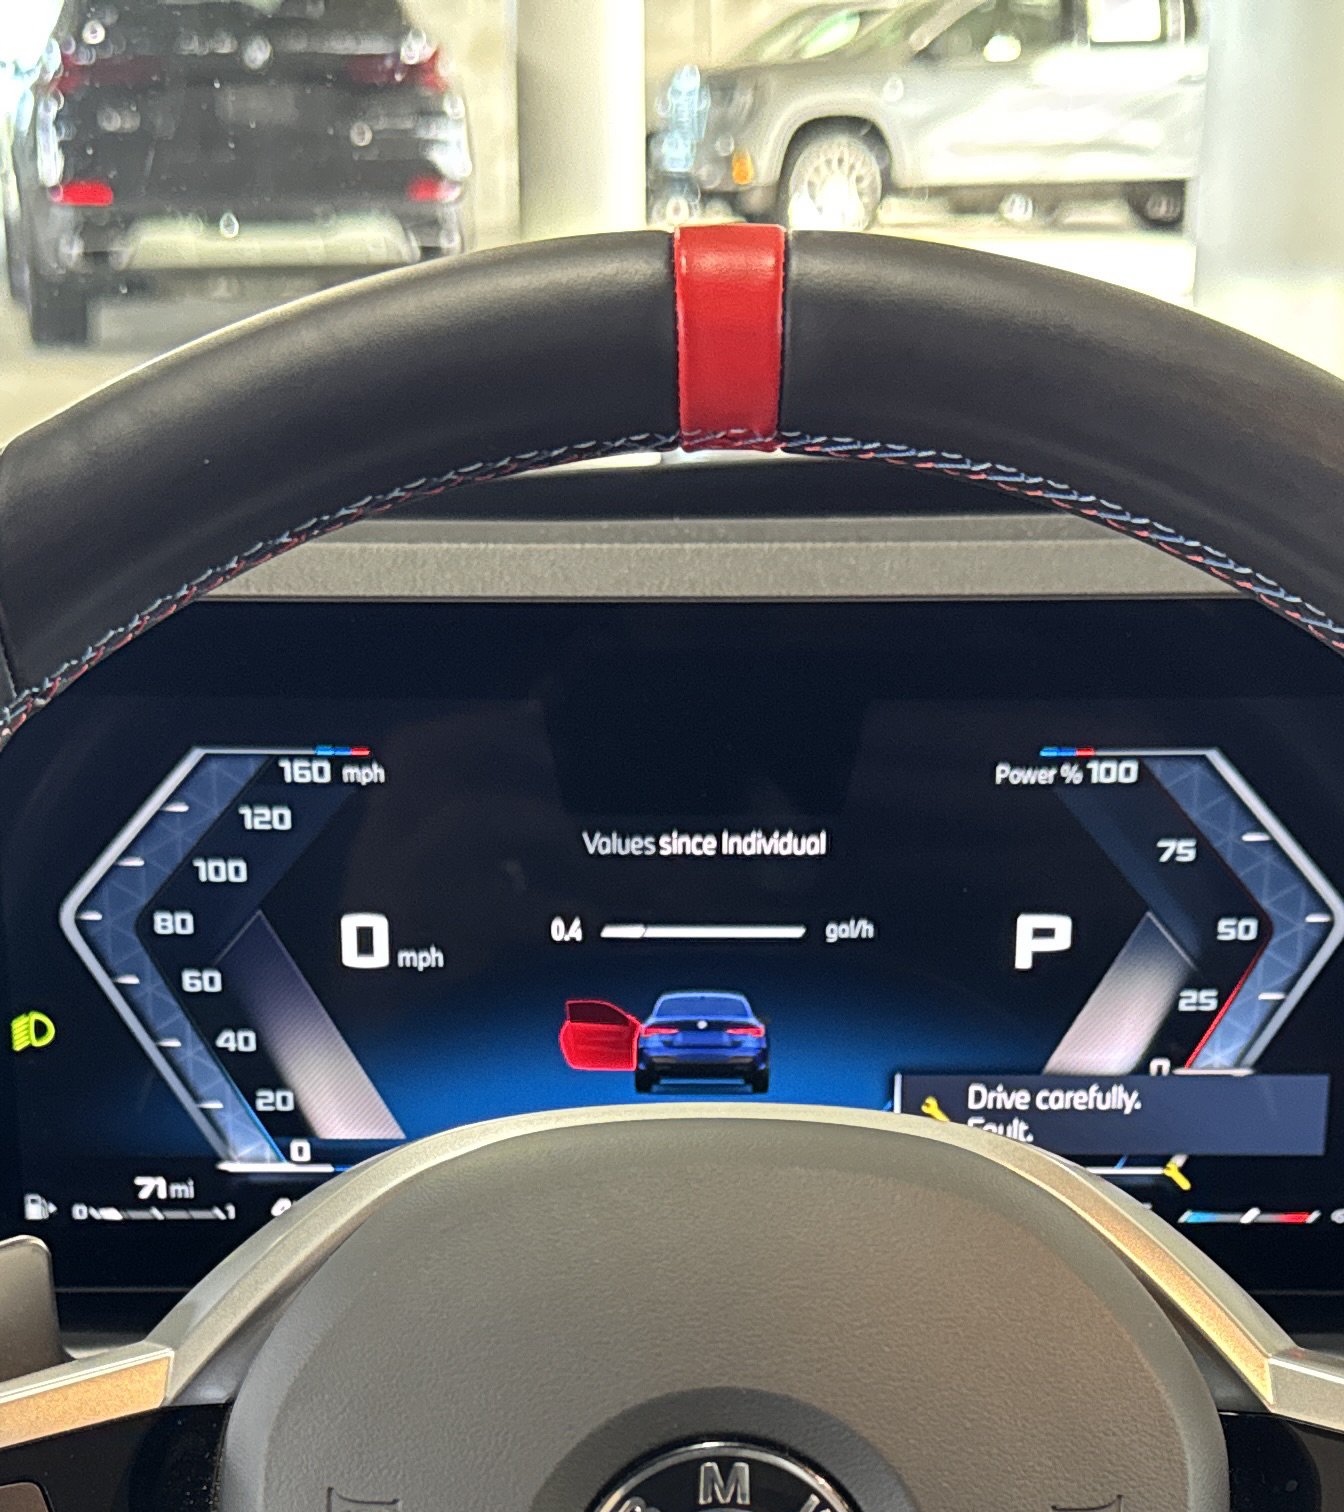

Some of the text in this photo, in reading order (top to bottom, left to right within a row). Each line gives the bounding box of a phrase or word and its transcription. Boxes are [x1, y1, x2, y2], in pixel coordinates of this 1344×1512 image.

[278, 760, 386, 786] 160 mph
[995, 760, 1139, 785] Power % 100
[238, 806, 292, 831] 120
[582, 829, 827, 856] Values since Individual
[1156, 838, 1197, 863] 75
[193, 858, 248, 883] 100
[153, 911, 195, 935] 80
[550, 916, 875, 943] 0.4 gal/h
[1216, 917, 1259, 941] 50
[341, 913, 445, 972] 0 mph
[1014, 913, 1073, 970] P
[181, 969, 222, 993] 60
[1178, 989, 1218, 1012] 25
[215, 1029, 257, 1052] 40
[255, 1090, 295, 1112] 20
[967, 1083, 1142, 1115] Drive carefully.
[290, 1139, 311, 1163] 0
[72, 1203, 89, 1220] 0
